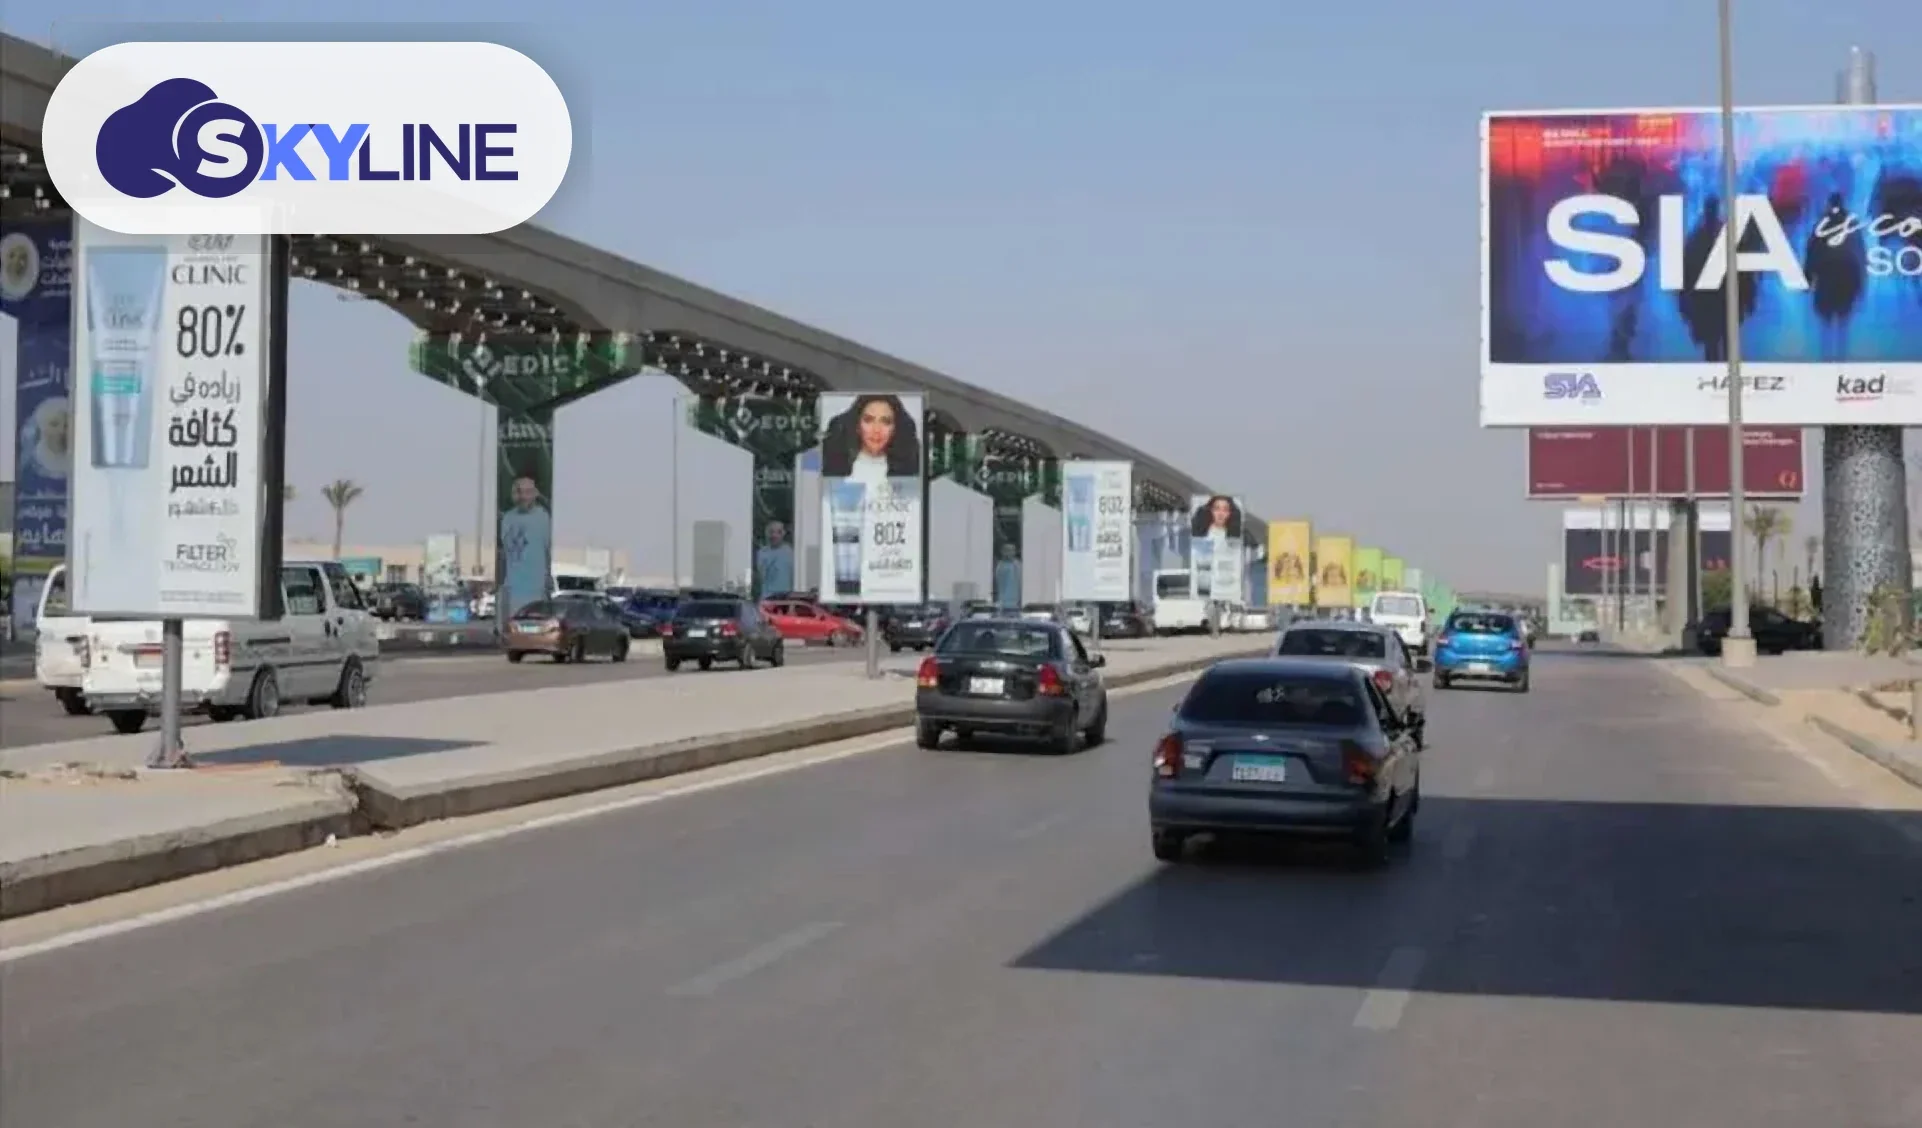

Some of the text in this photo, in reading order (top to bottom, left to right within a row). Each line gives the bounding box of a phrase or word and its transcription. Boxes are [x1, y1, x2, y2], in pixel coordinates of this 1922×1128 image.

[1543, 193, 1809, 292] SIA
[172, 264, 249, 285] CLINIC
[1866, 246, 1922, 276] SO
[177, 304, 245, 357] 80%
[169, 371, 195, 404] في
[1543, 373, 1602, 399] SIA
[1836, 373, 1886, 395] kad
[169, 408, 238, 447] كثافة
[170, 450, 238, 493] الشعر
[874, 520, 906, 545] 80%
[176, 544, 227, 560] FILTER
